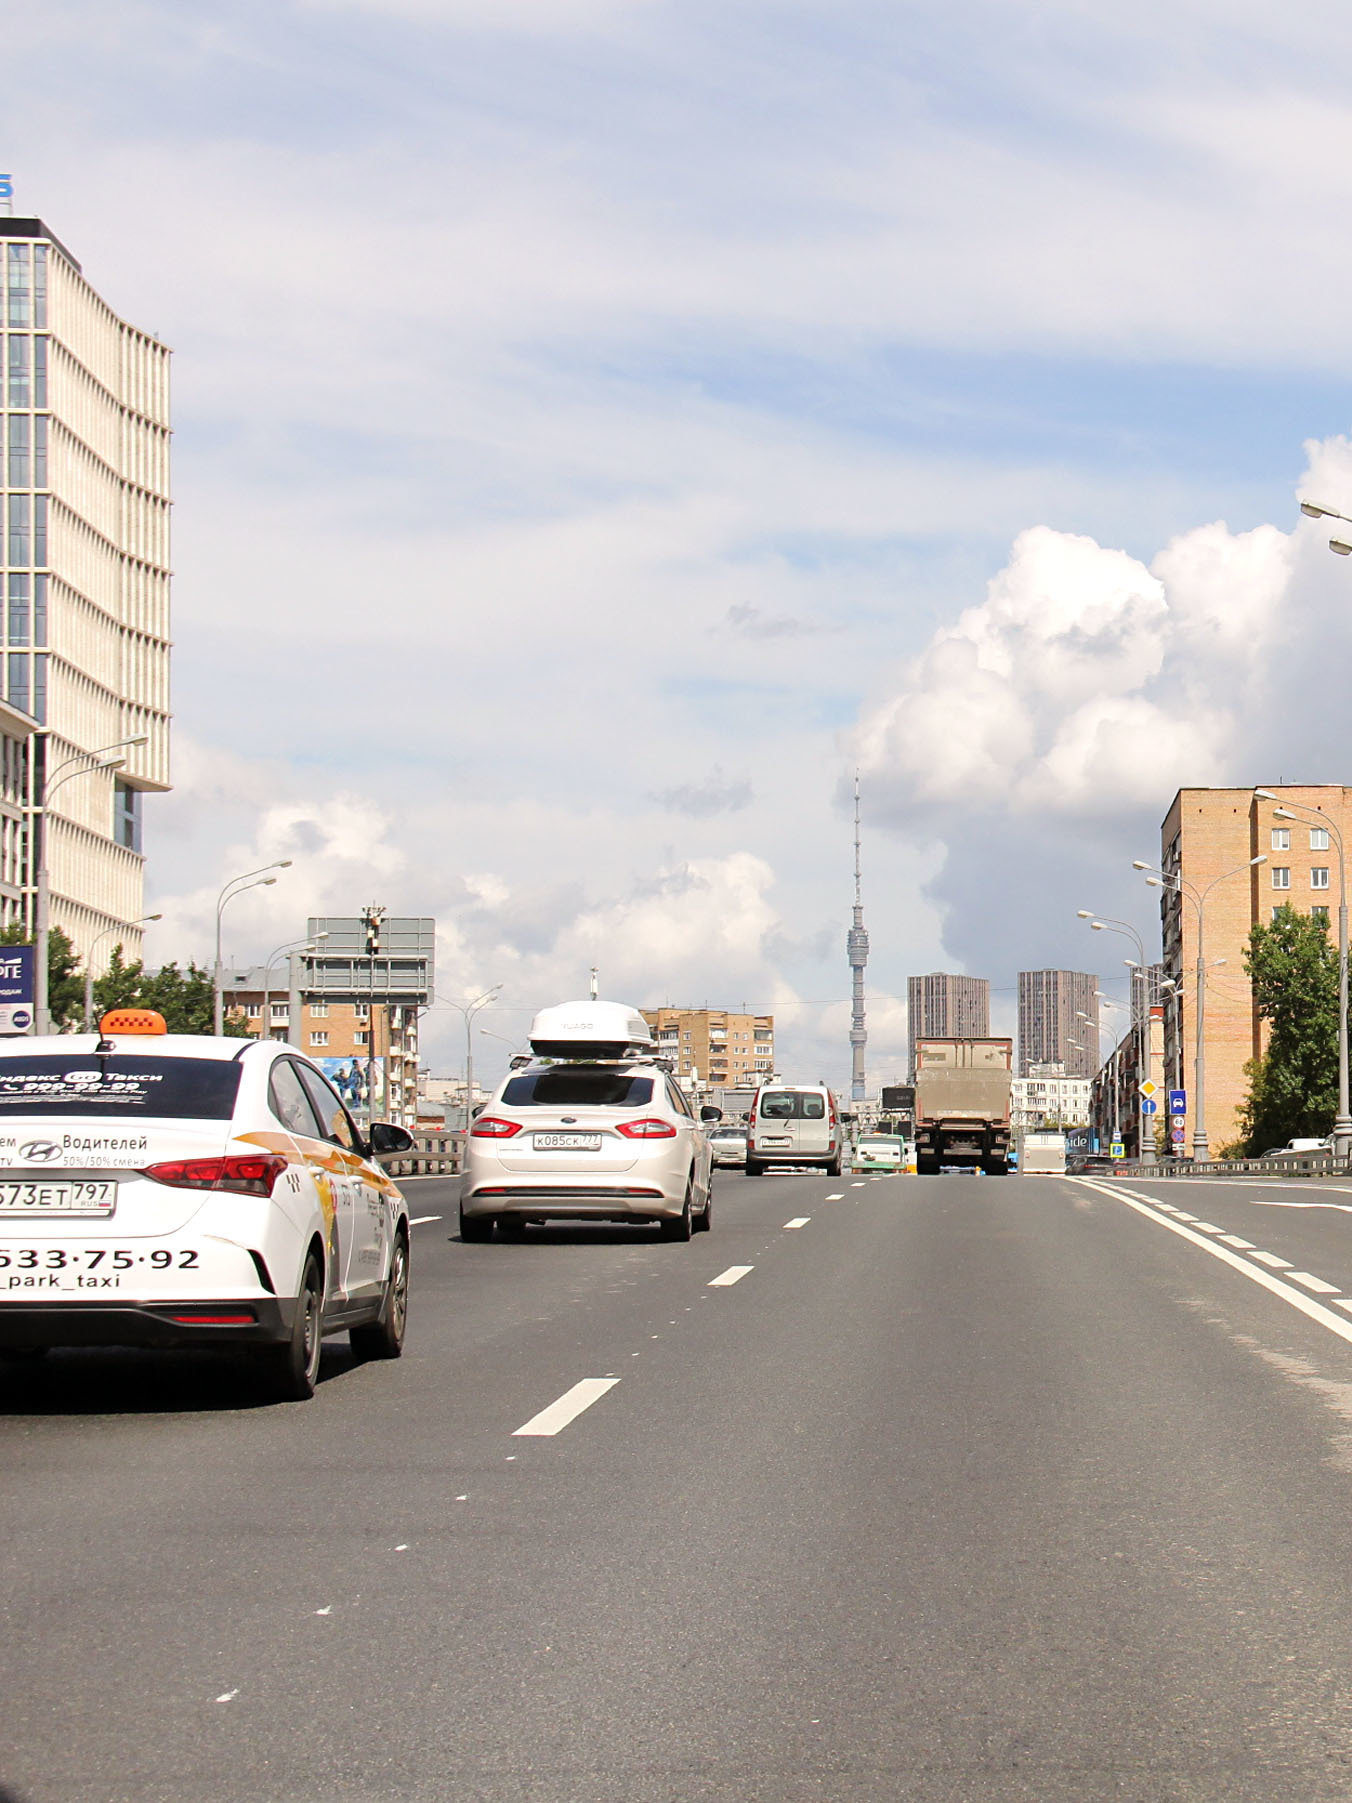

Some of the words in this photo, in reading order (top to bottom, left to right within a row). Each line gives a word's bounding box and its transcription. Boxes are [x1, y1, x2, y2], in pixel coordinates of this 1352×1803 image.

[0, 1075, 61, 1083] ндекс
[105, 1073, 163, 1081] Такси
[23, 1082, 140, 1091] 999-99-99
[63, 1134, 147, 1151] Водителей
[63, 1156, 111, 1168] 50%/50%
[113, 1157, 146, 1166] смена
[74, 1183, 110, 1200] 797
